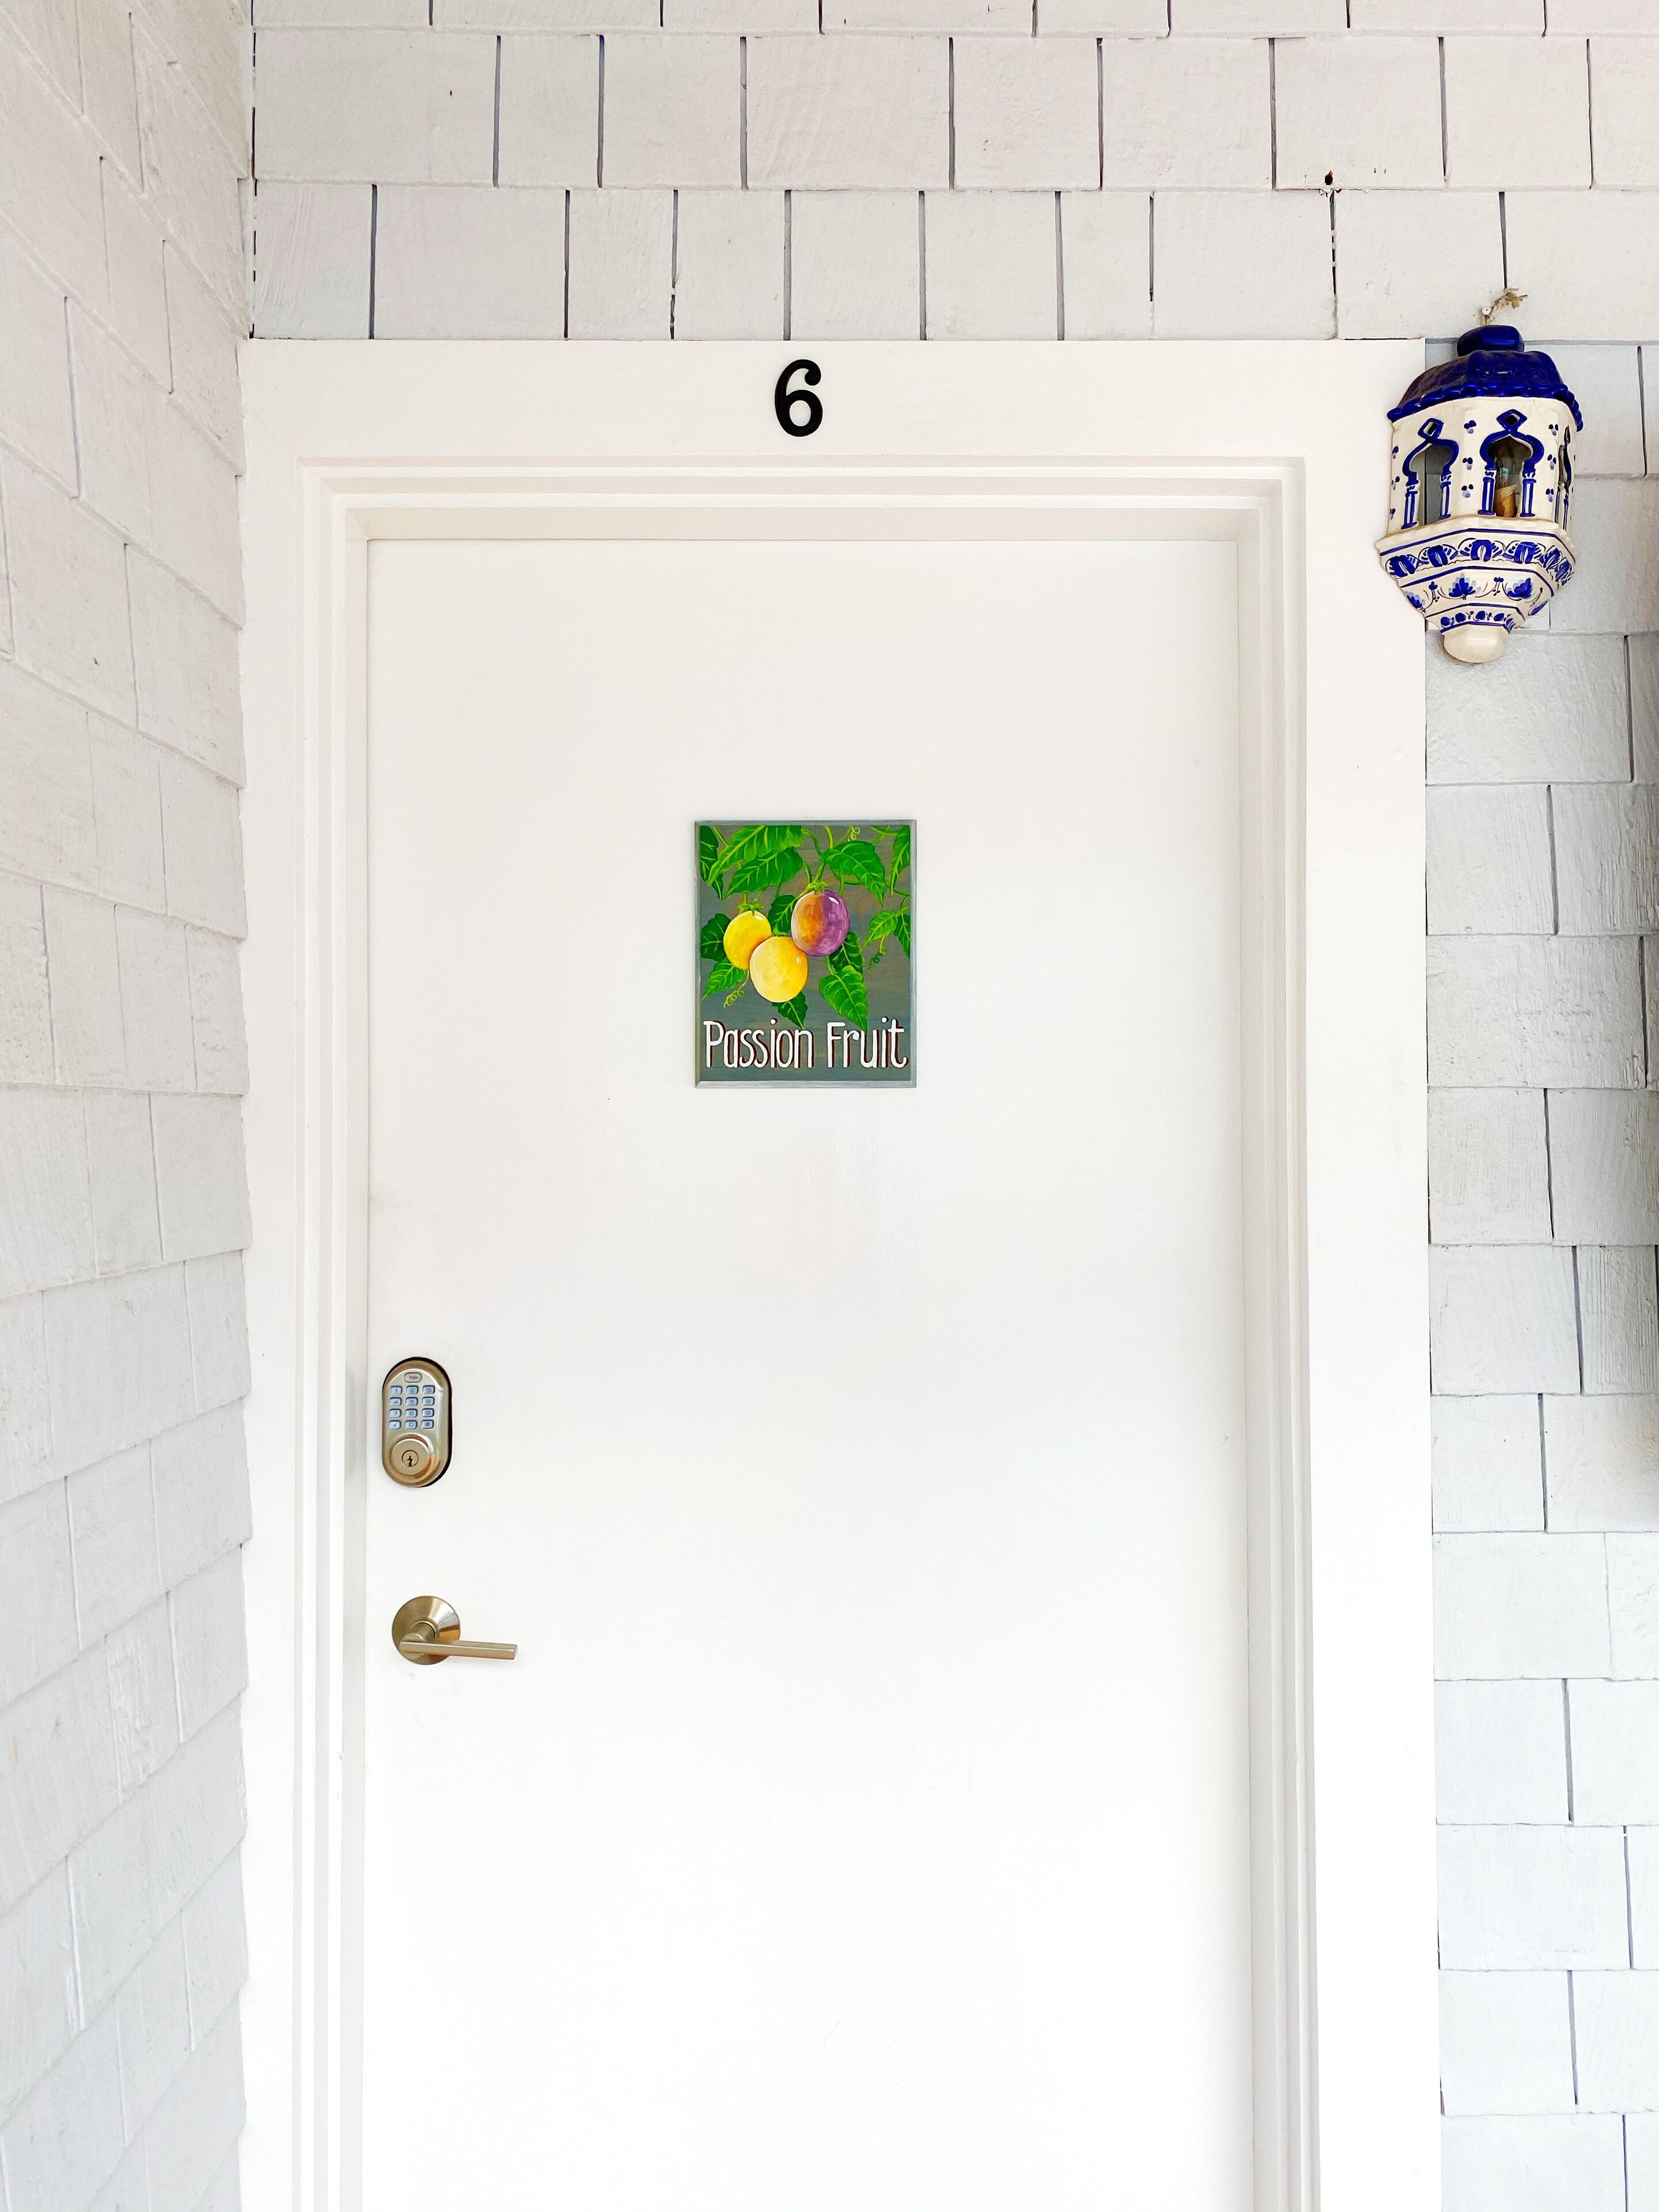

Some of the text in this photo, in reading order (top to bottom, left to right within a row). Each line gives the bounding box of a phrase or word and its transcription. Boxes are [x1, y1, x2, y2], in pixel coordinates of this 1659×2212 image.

[774, 359, 823, 437] 6
[703, 1017, 909, 1069] Passion Fruit
